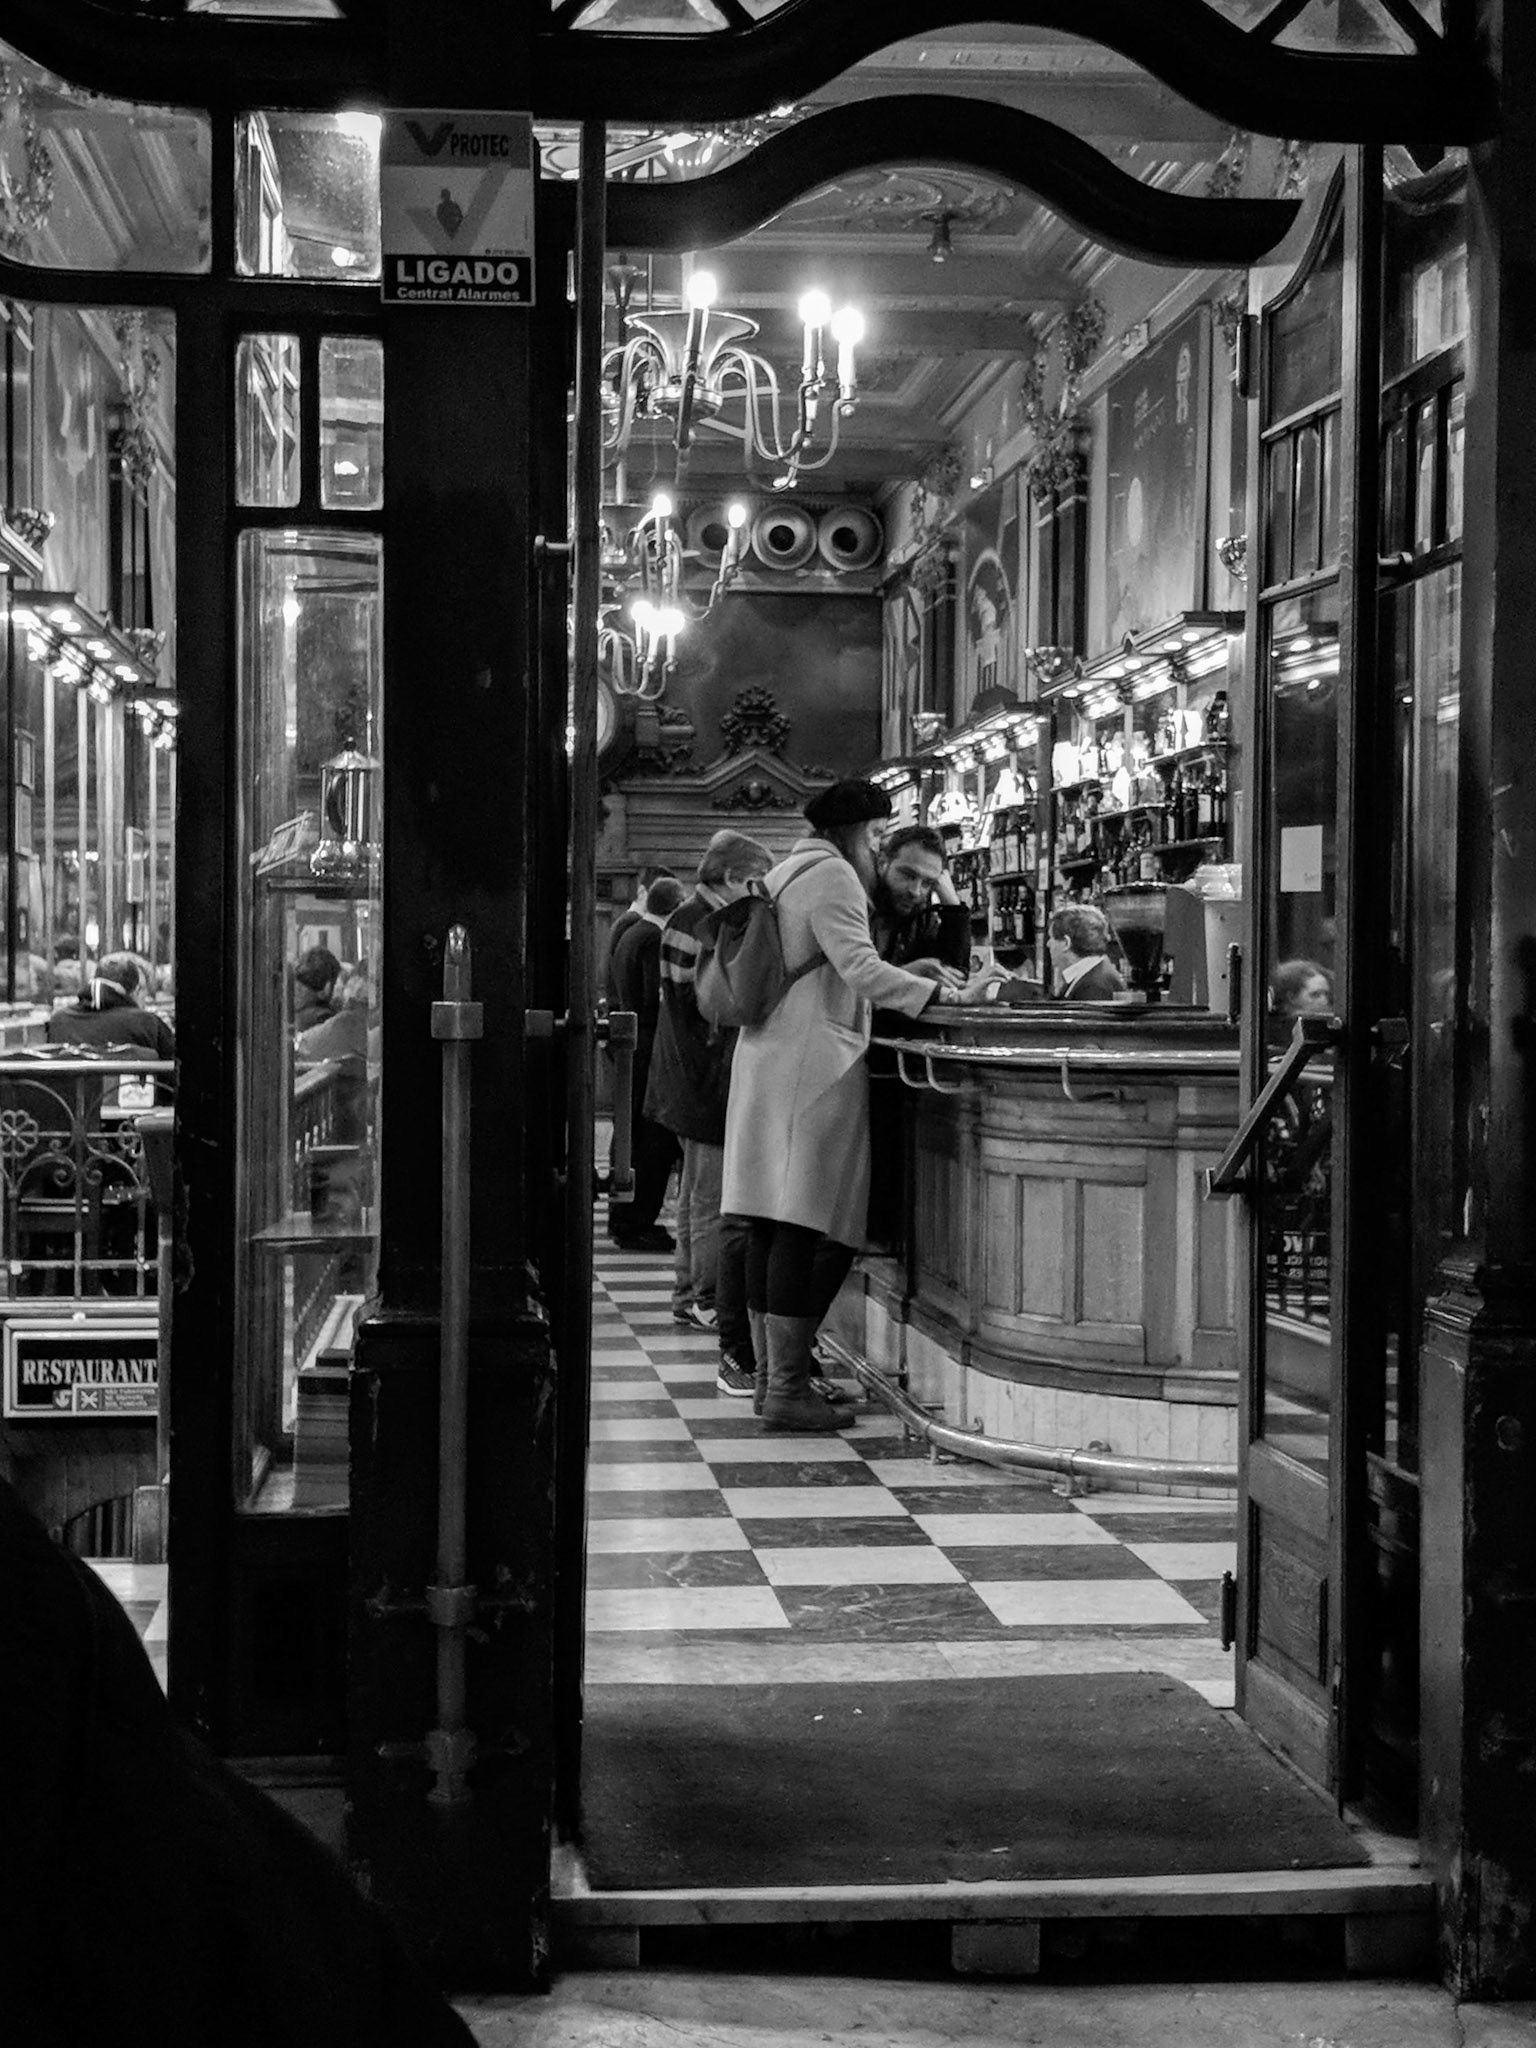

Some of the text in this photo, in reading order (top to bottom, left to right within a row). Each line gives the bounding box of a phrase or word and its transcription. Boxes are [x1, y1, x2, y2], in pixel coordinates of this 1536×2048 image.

[397, 260, 519, 285] LIGADO
[397, 286, 520, 301] Central Alarmes
[22, 1359, 157, 1385] RESTAURANT
